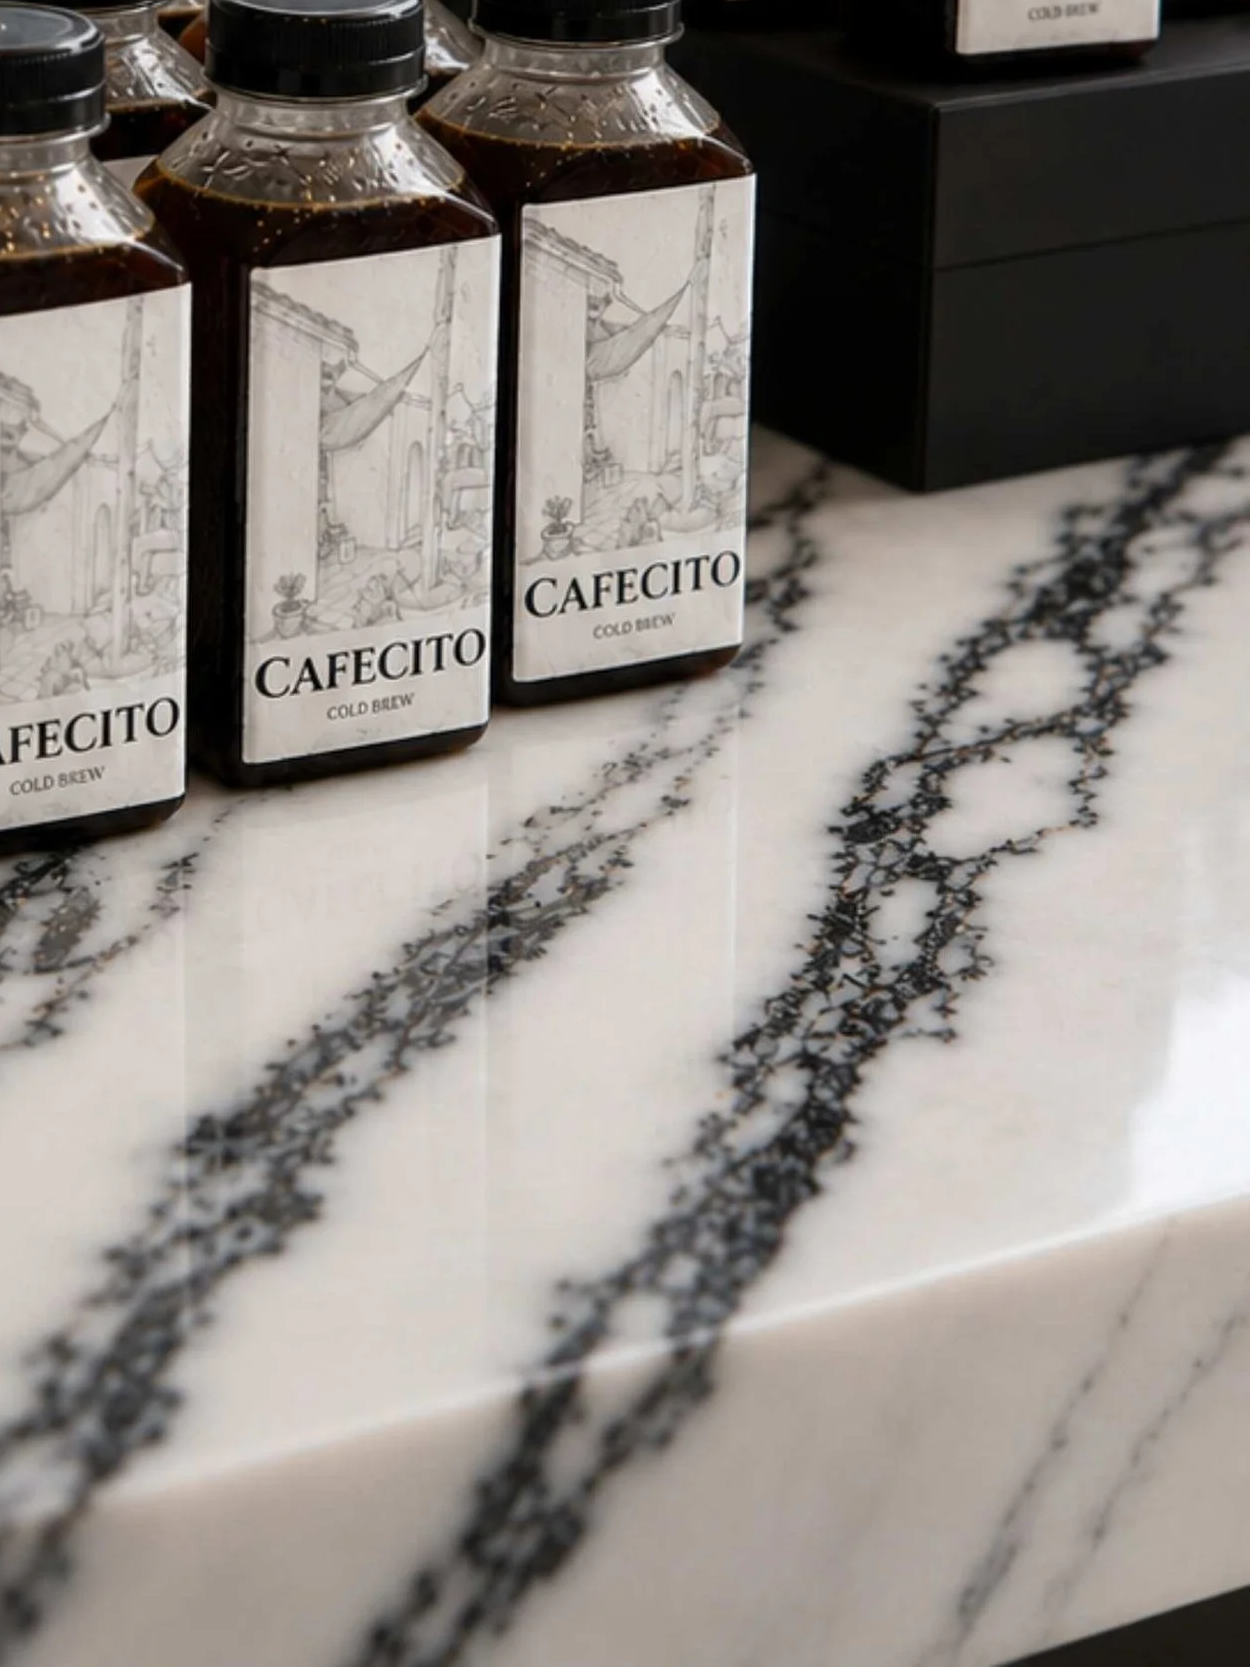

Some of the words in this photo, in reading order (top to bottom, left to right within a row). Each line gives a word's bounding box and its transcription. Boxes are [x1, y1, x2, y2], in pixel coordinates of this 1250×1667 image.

[524, 550, 741, 618] CAFECITO
[593, 620, 633, 639] COLD
[255, 628, 487, 698] CAFECITO
[327, 701, 369, 721] COLD
[372, 692, 415, 714] BREW
[9, 775, 54, 796] COLD
[59, 766, 105, 788] BREW
